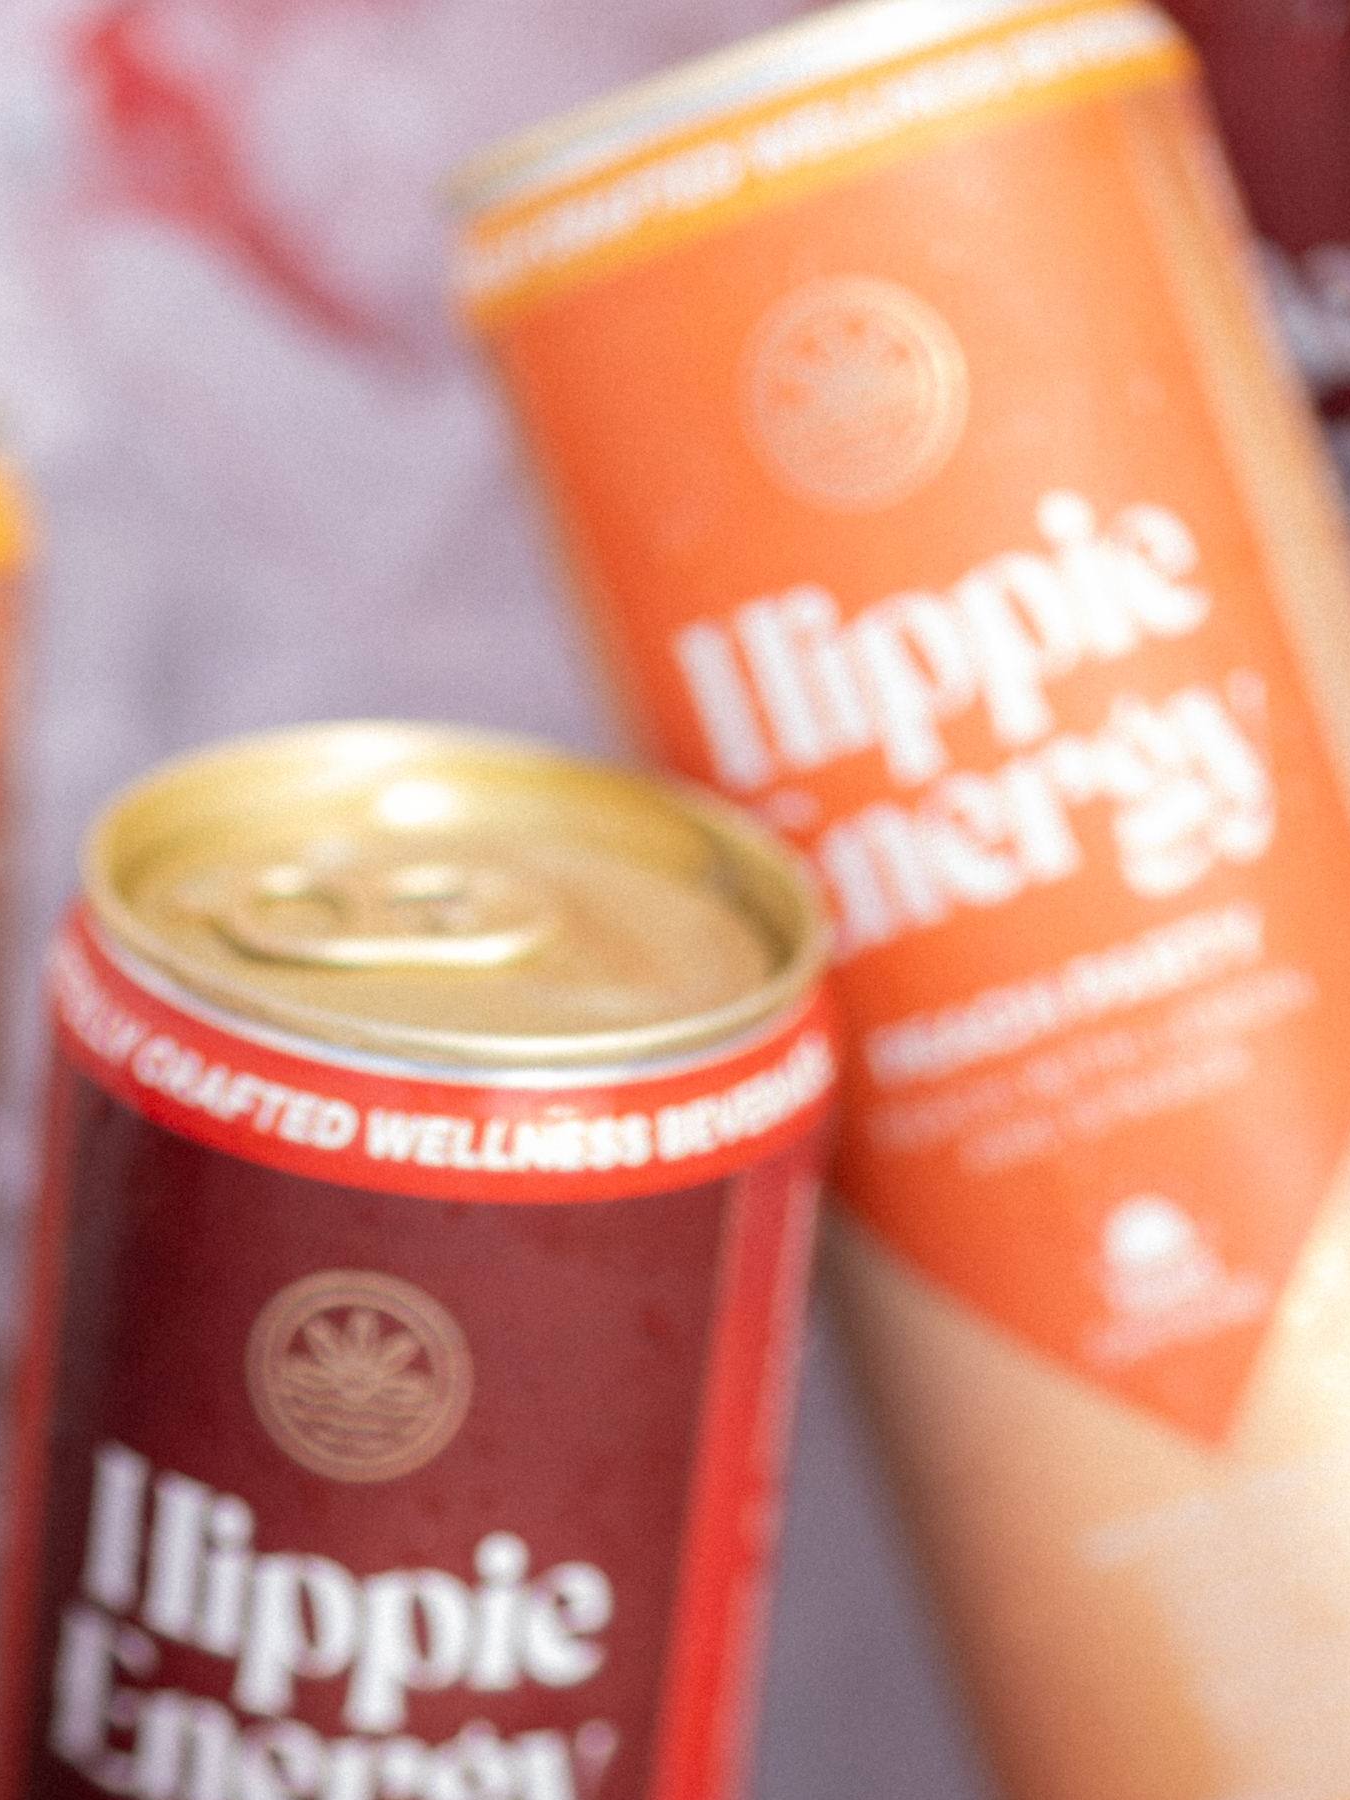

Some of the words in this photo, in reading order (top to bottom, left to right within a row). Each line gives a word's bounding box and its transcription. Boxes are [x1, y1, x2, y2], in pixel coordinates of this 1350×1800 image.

[670, 486, 1215, 790] Hippie
[765, 667, 1278, 945] nergy
[364, 1106, 652, 1172] WELLNESS
[82, 1440, 615, 1735] Hippie
